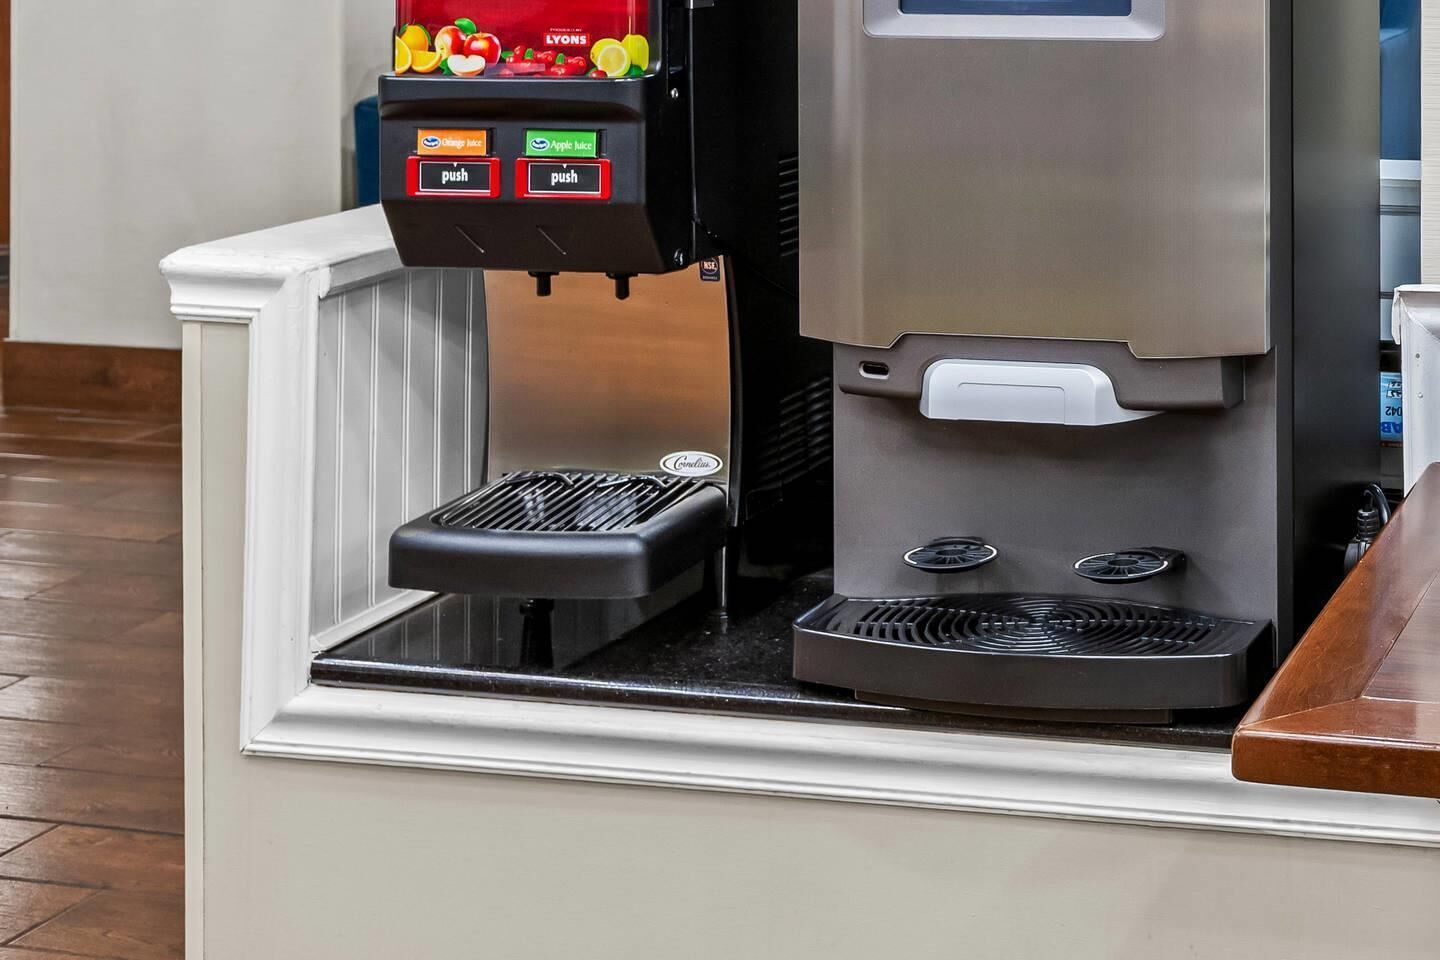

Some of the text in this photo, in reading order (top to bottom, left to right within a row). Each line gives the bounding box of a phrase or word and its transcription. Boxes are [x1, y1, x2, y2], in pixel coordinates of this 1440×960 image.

[546, 34, 587, 44] LYONS
[466, 138, 482, 148] Juice
[550, 140, 573, 152] Apple
[574, 140, 592, 150] Juice
[441, 168, 468, 184] push
[550, 169, 578, 186] push
[674, 455, 711, 470] Cornelius
